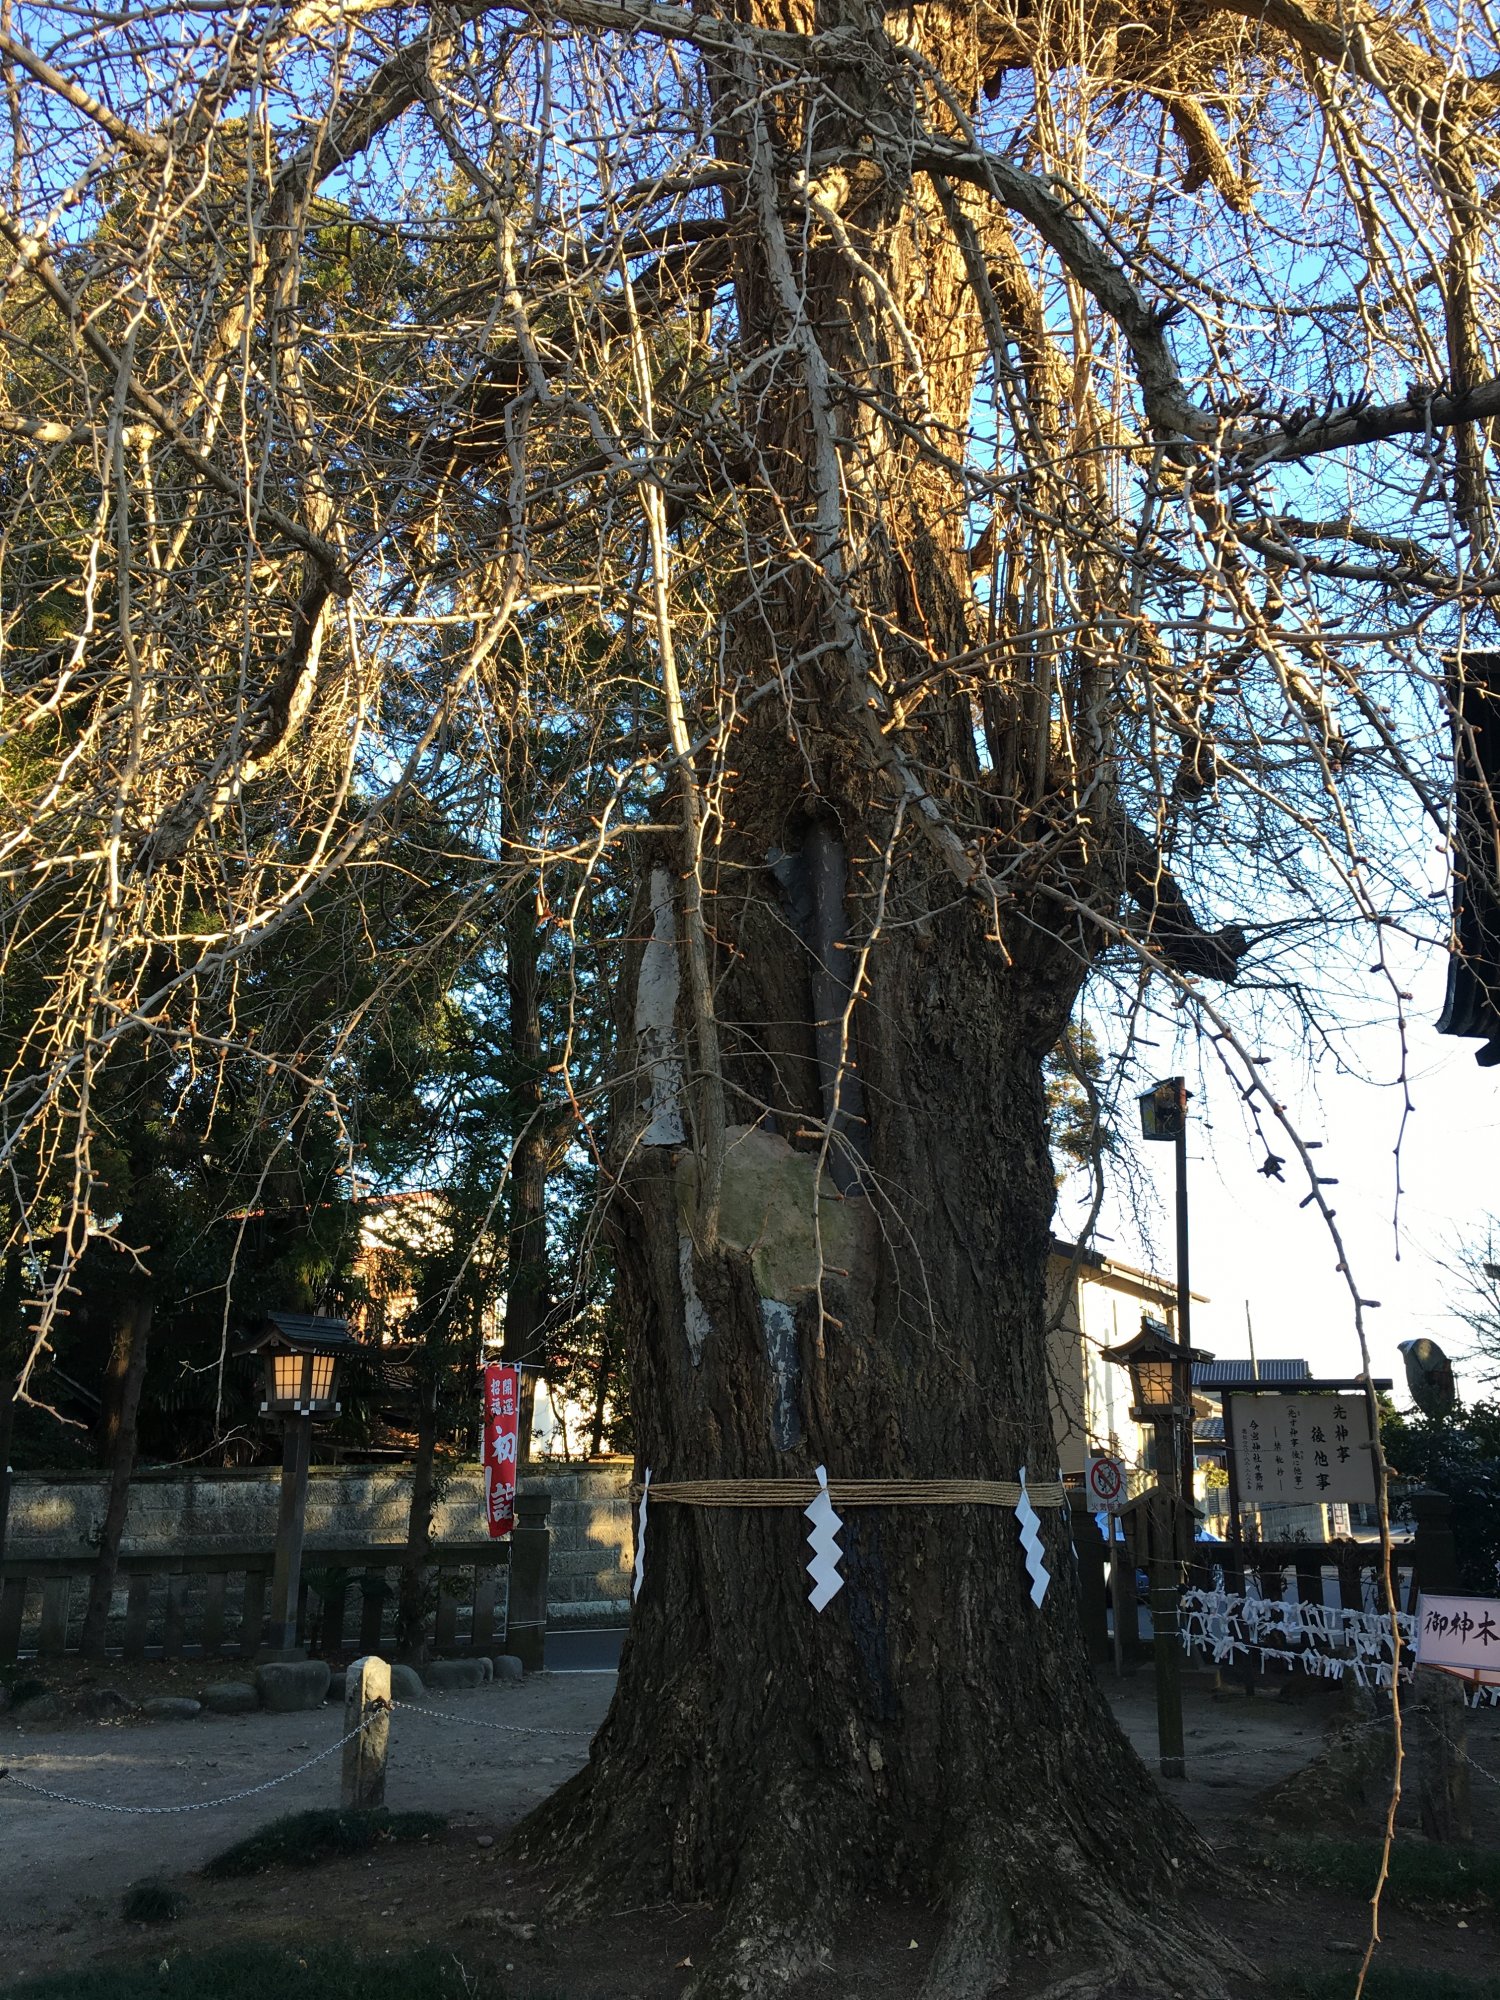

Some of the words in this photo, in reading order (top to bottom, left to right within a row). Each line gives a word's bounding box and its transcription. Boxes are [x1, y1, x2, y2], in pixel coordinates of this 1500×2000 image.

[490, 1378, 503, 1416] 招福
[502, 1378, 516, 1416] 開運
[1333, 1404, 1350, 1463] 先神事
[490, 1425, 516, 1522] 初詣
[1311, 1426, 1331, 1491] 後他事
[1424, 1611, 1500, 1646] 御神木
